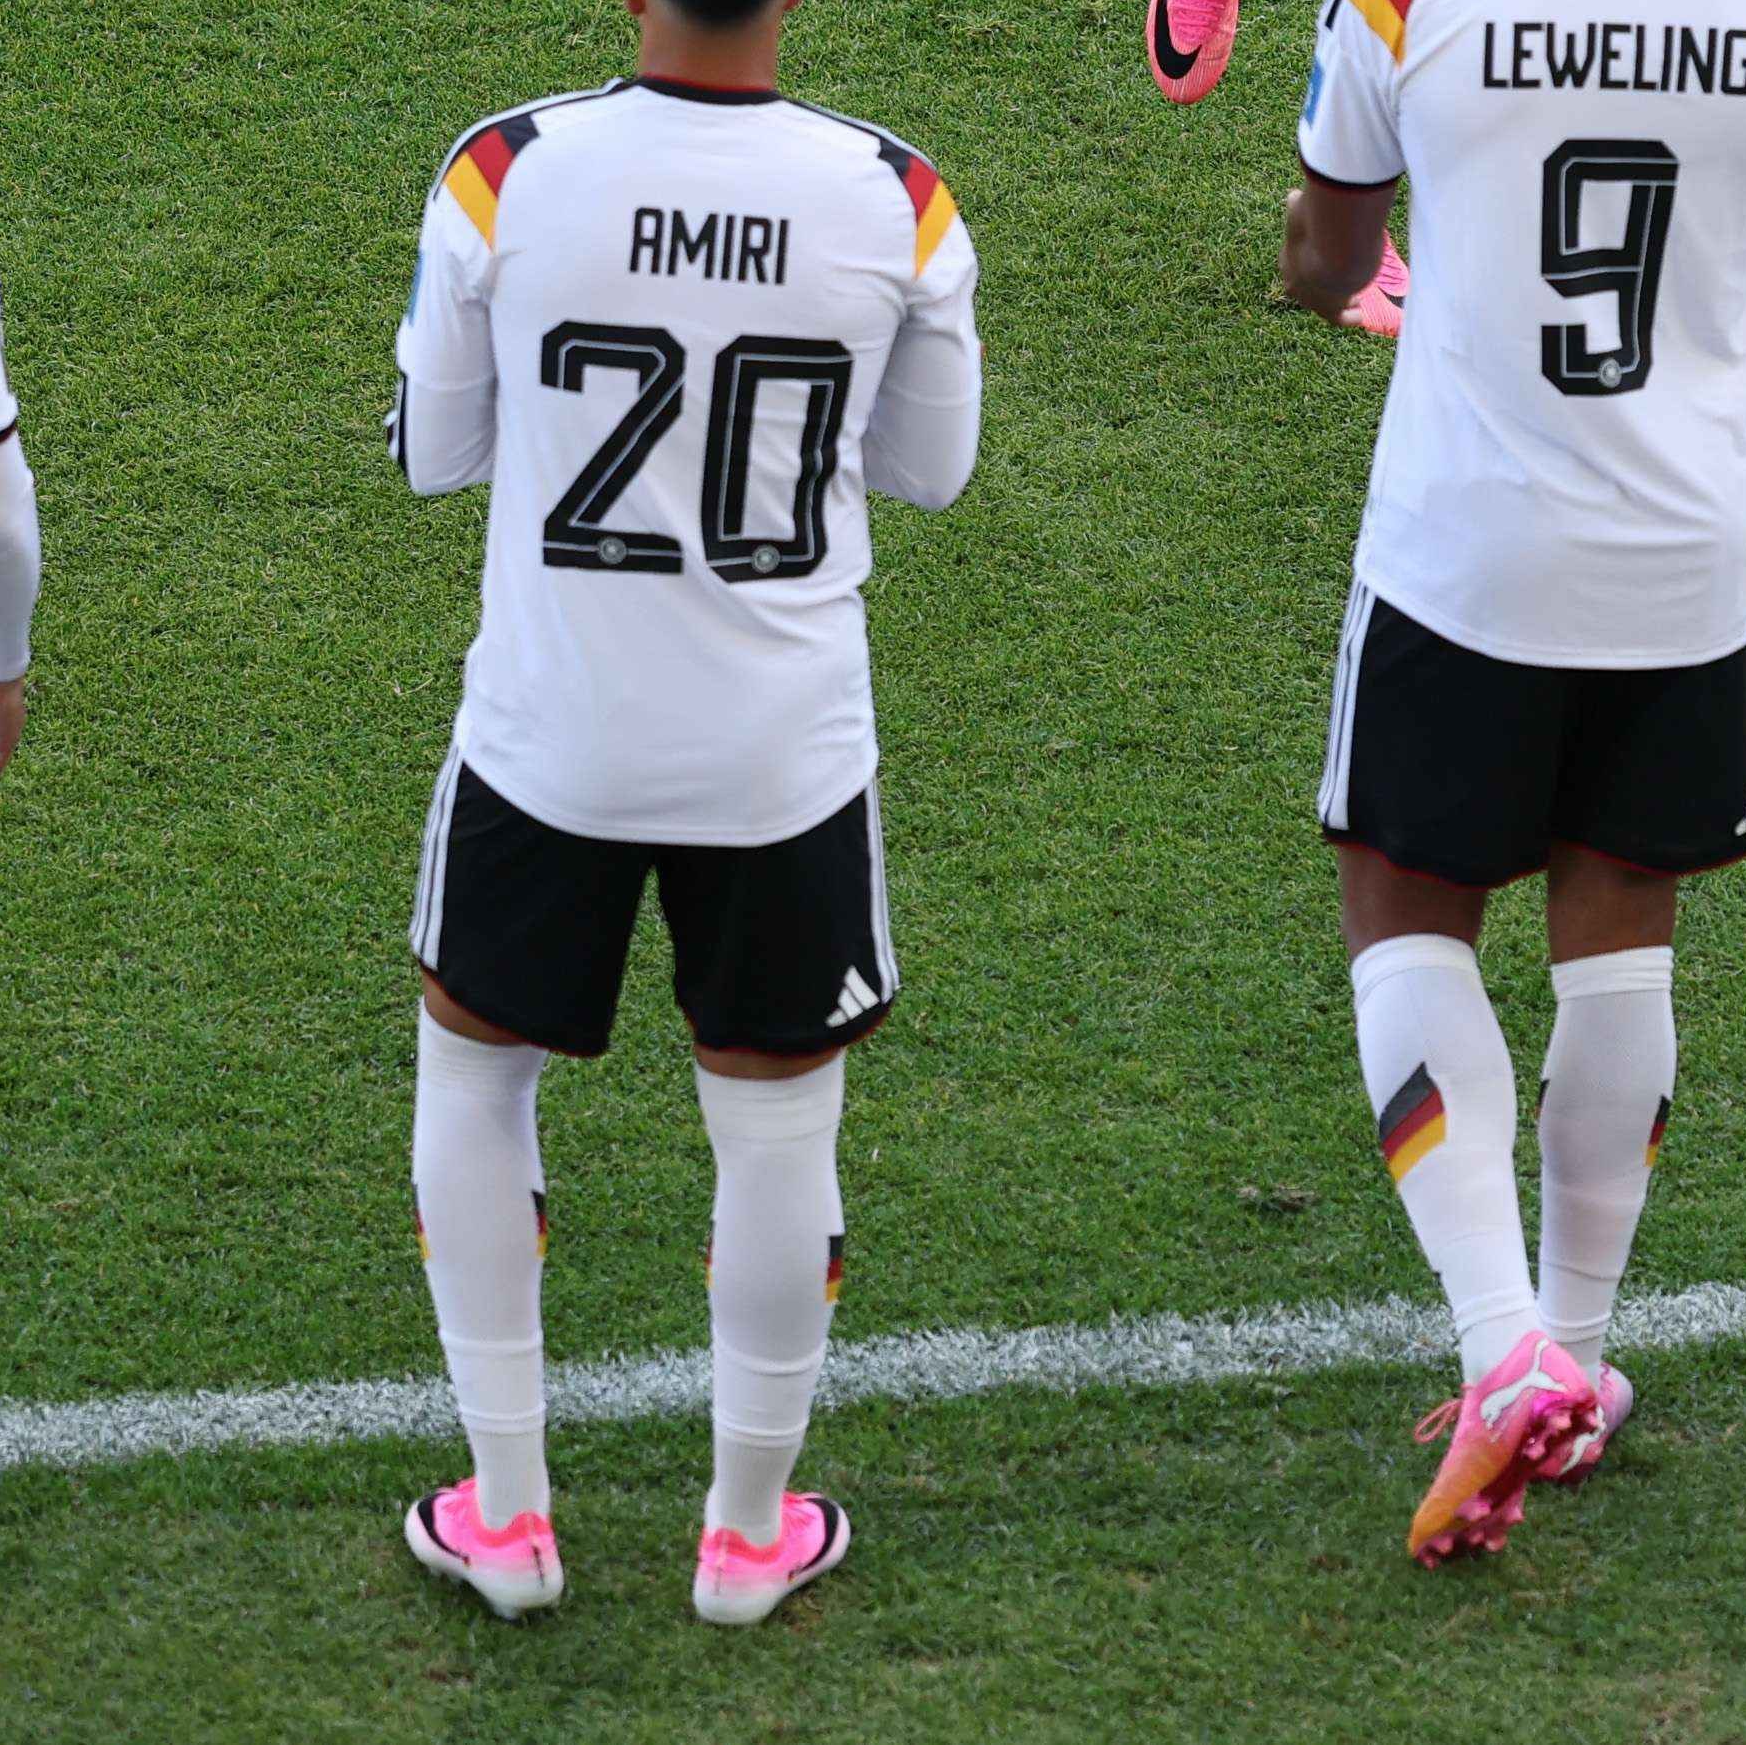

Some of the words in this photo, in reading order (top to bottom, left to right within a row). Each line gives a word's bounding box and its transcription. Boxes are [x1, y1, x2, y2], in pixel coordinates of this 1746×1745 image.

[629, 207, 789, 286] AMIRI
[1540, 139, 1679, 397] 9
[540, 320, 854, 584] 20
